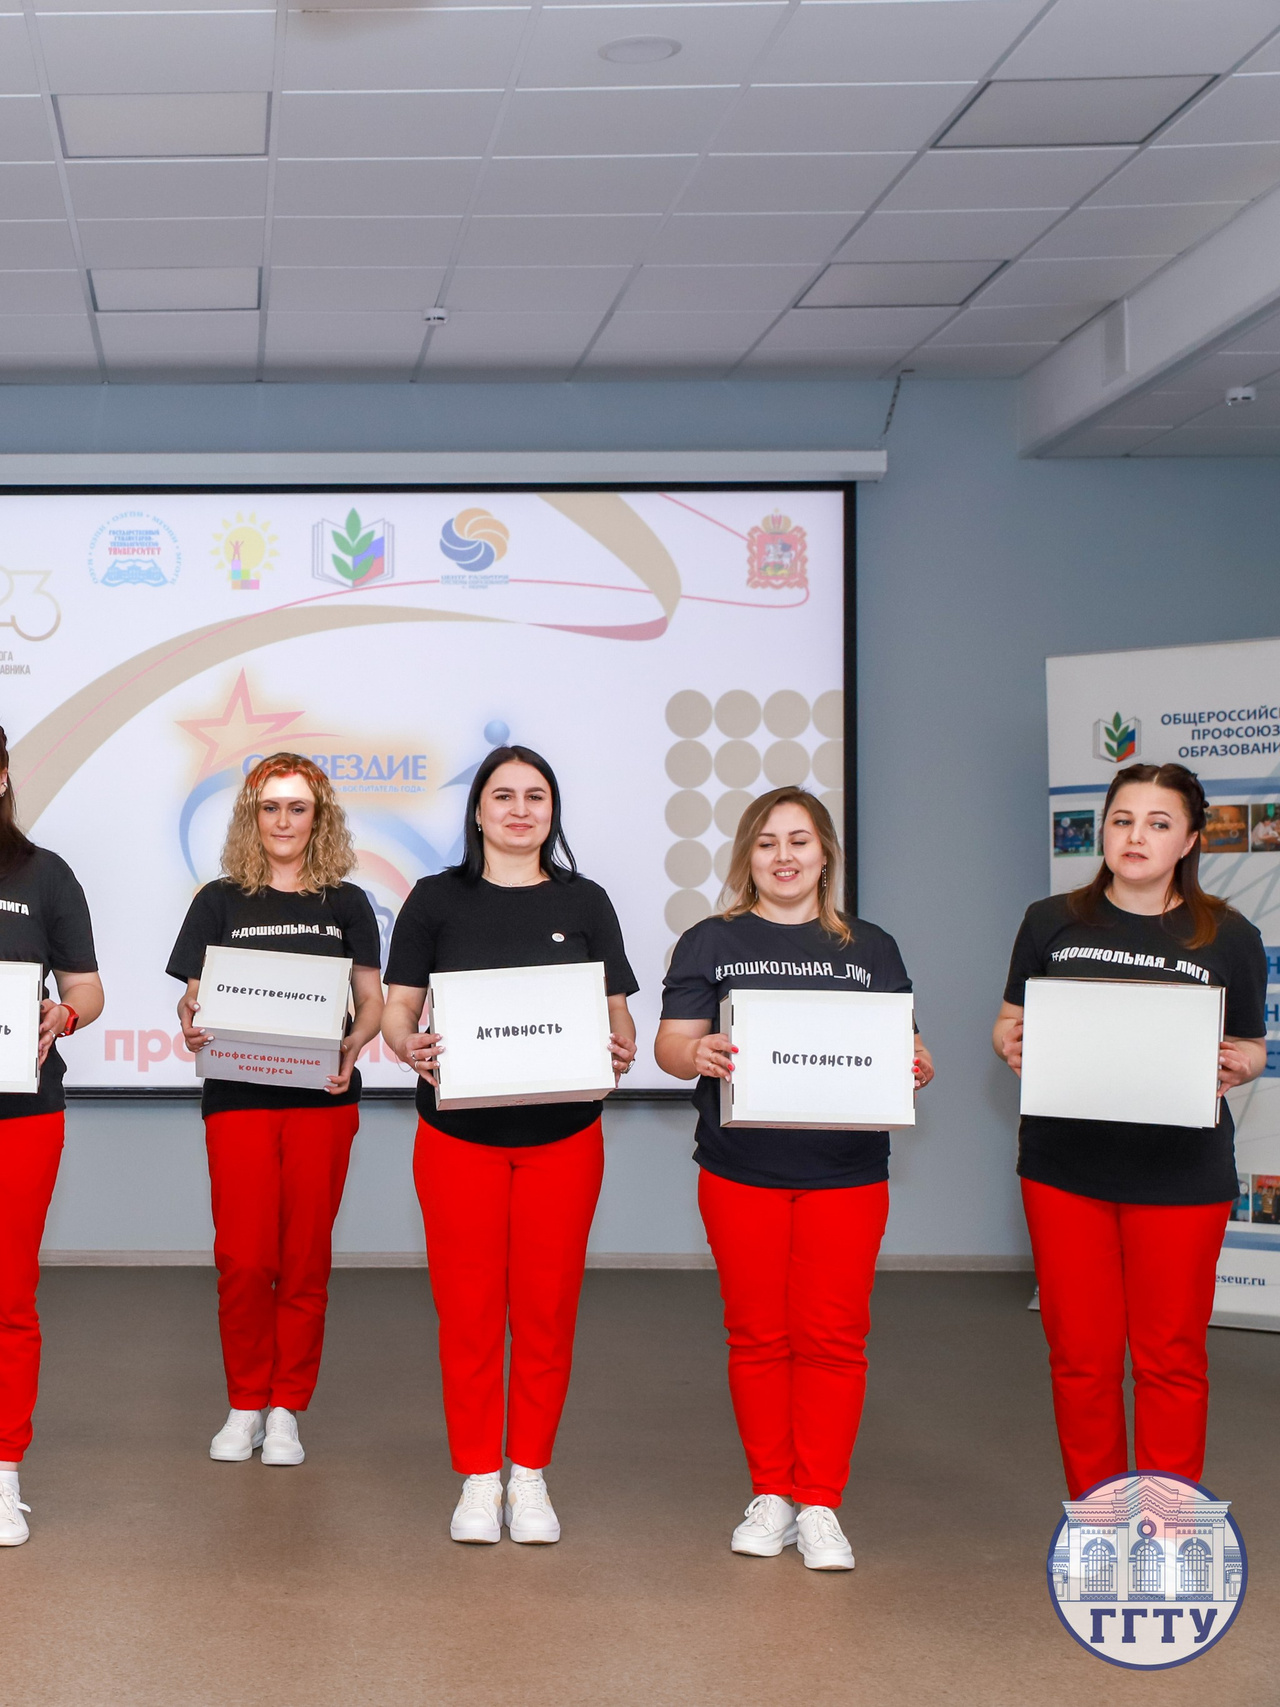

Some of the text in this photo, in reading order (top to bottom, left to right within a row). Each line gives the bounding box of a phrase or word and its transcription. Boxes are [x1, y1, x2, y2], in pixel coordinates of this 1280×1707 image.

[1161, 705, 1280, 727] ОБЩЕРОССИЙС
[1191, 724, 1280, 740] ПРОФСОЮЗ
[217, 984, 326, 1003] Ответственность
[476, 1023, 563, 1040] Активность
[210, 1049, 321, 1066] Профессиональные
[772, 1050, 872, 1068] Постоянство
[238, 1064, 293, 1075] конкурсы
